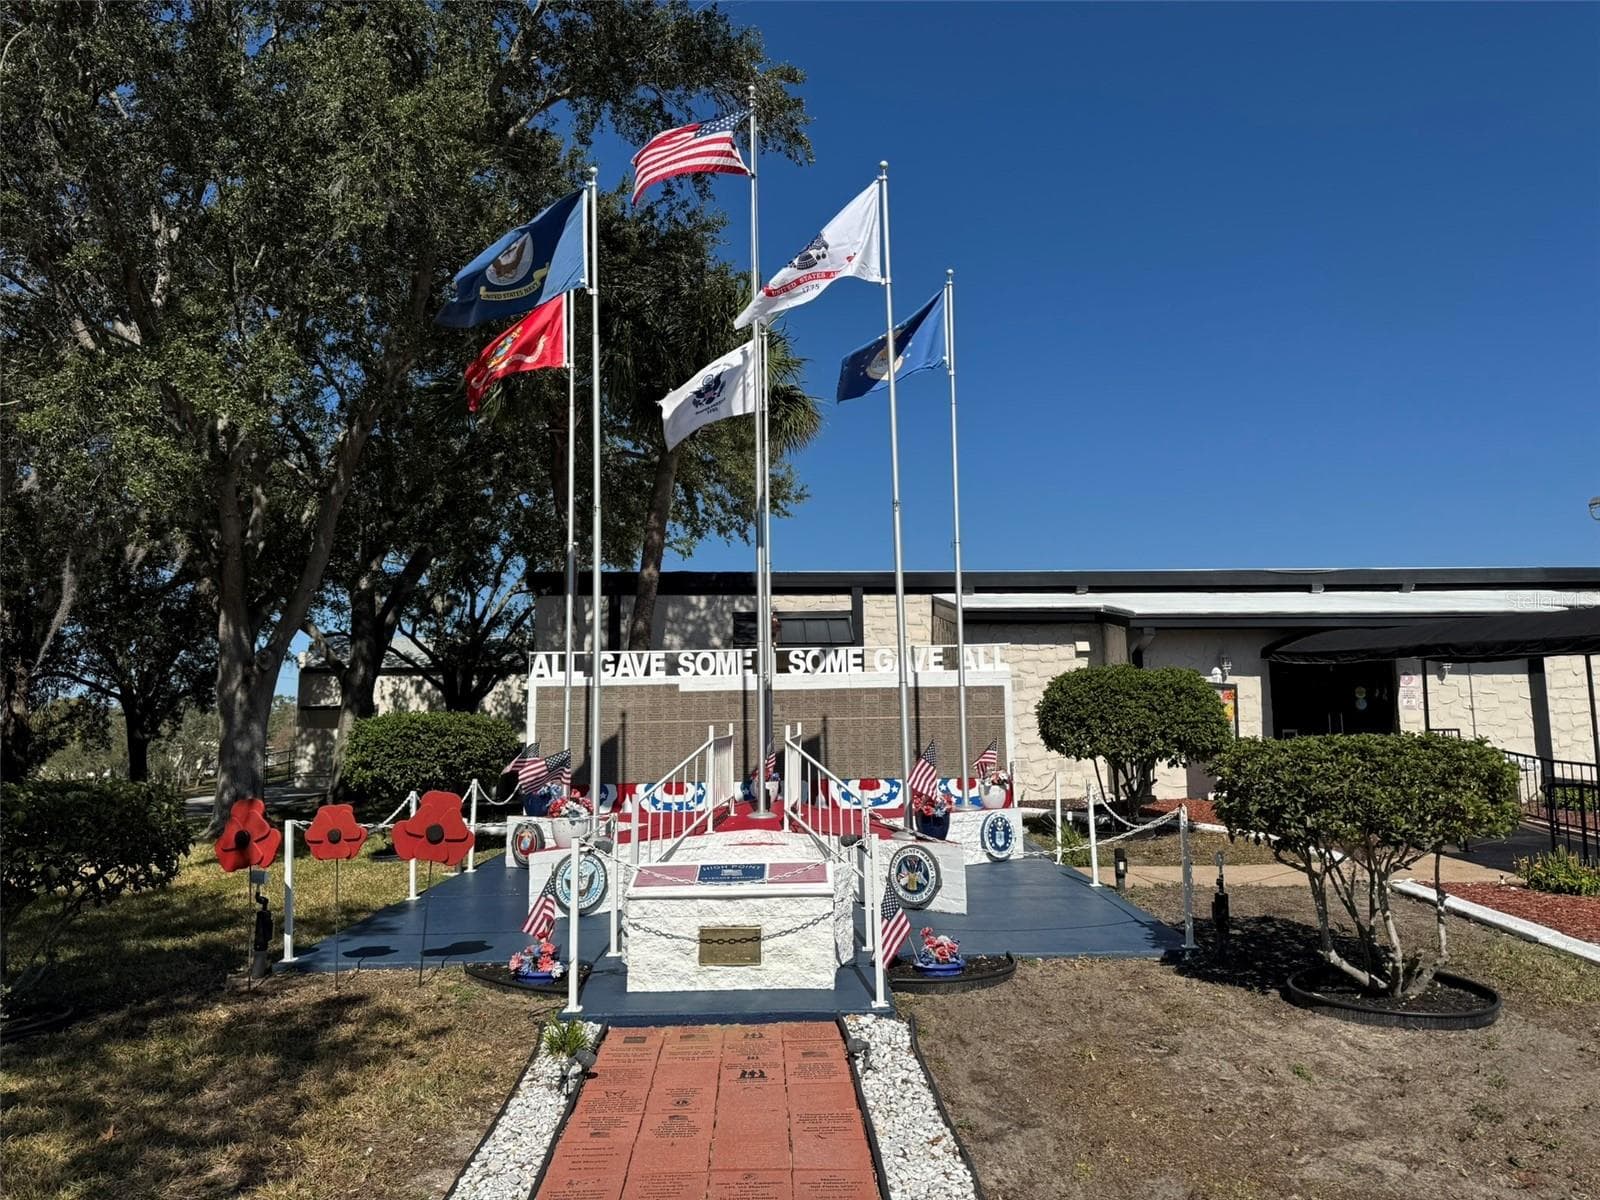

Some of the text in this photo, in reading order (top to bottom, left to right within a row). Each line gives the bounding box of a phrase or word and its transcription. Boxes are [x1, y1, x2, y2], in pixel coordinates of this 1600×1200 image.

[800, 271, 826, 283] STATES
[530, 653, 584, 678] ALL
[600, 653, 666, 678] GAVE
[677, 651, 753, 676] SOME
[788, 650, 863, 674] SOME
[963, 646, 1010, 672] ALL
